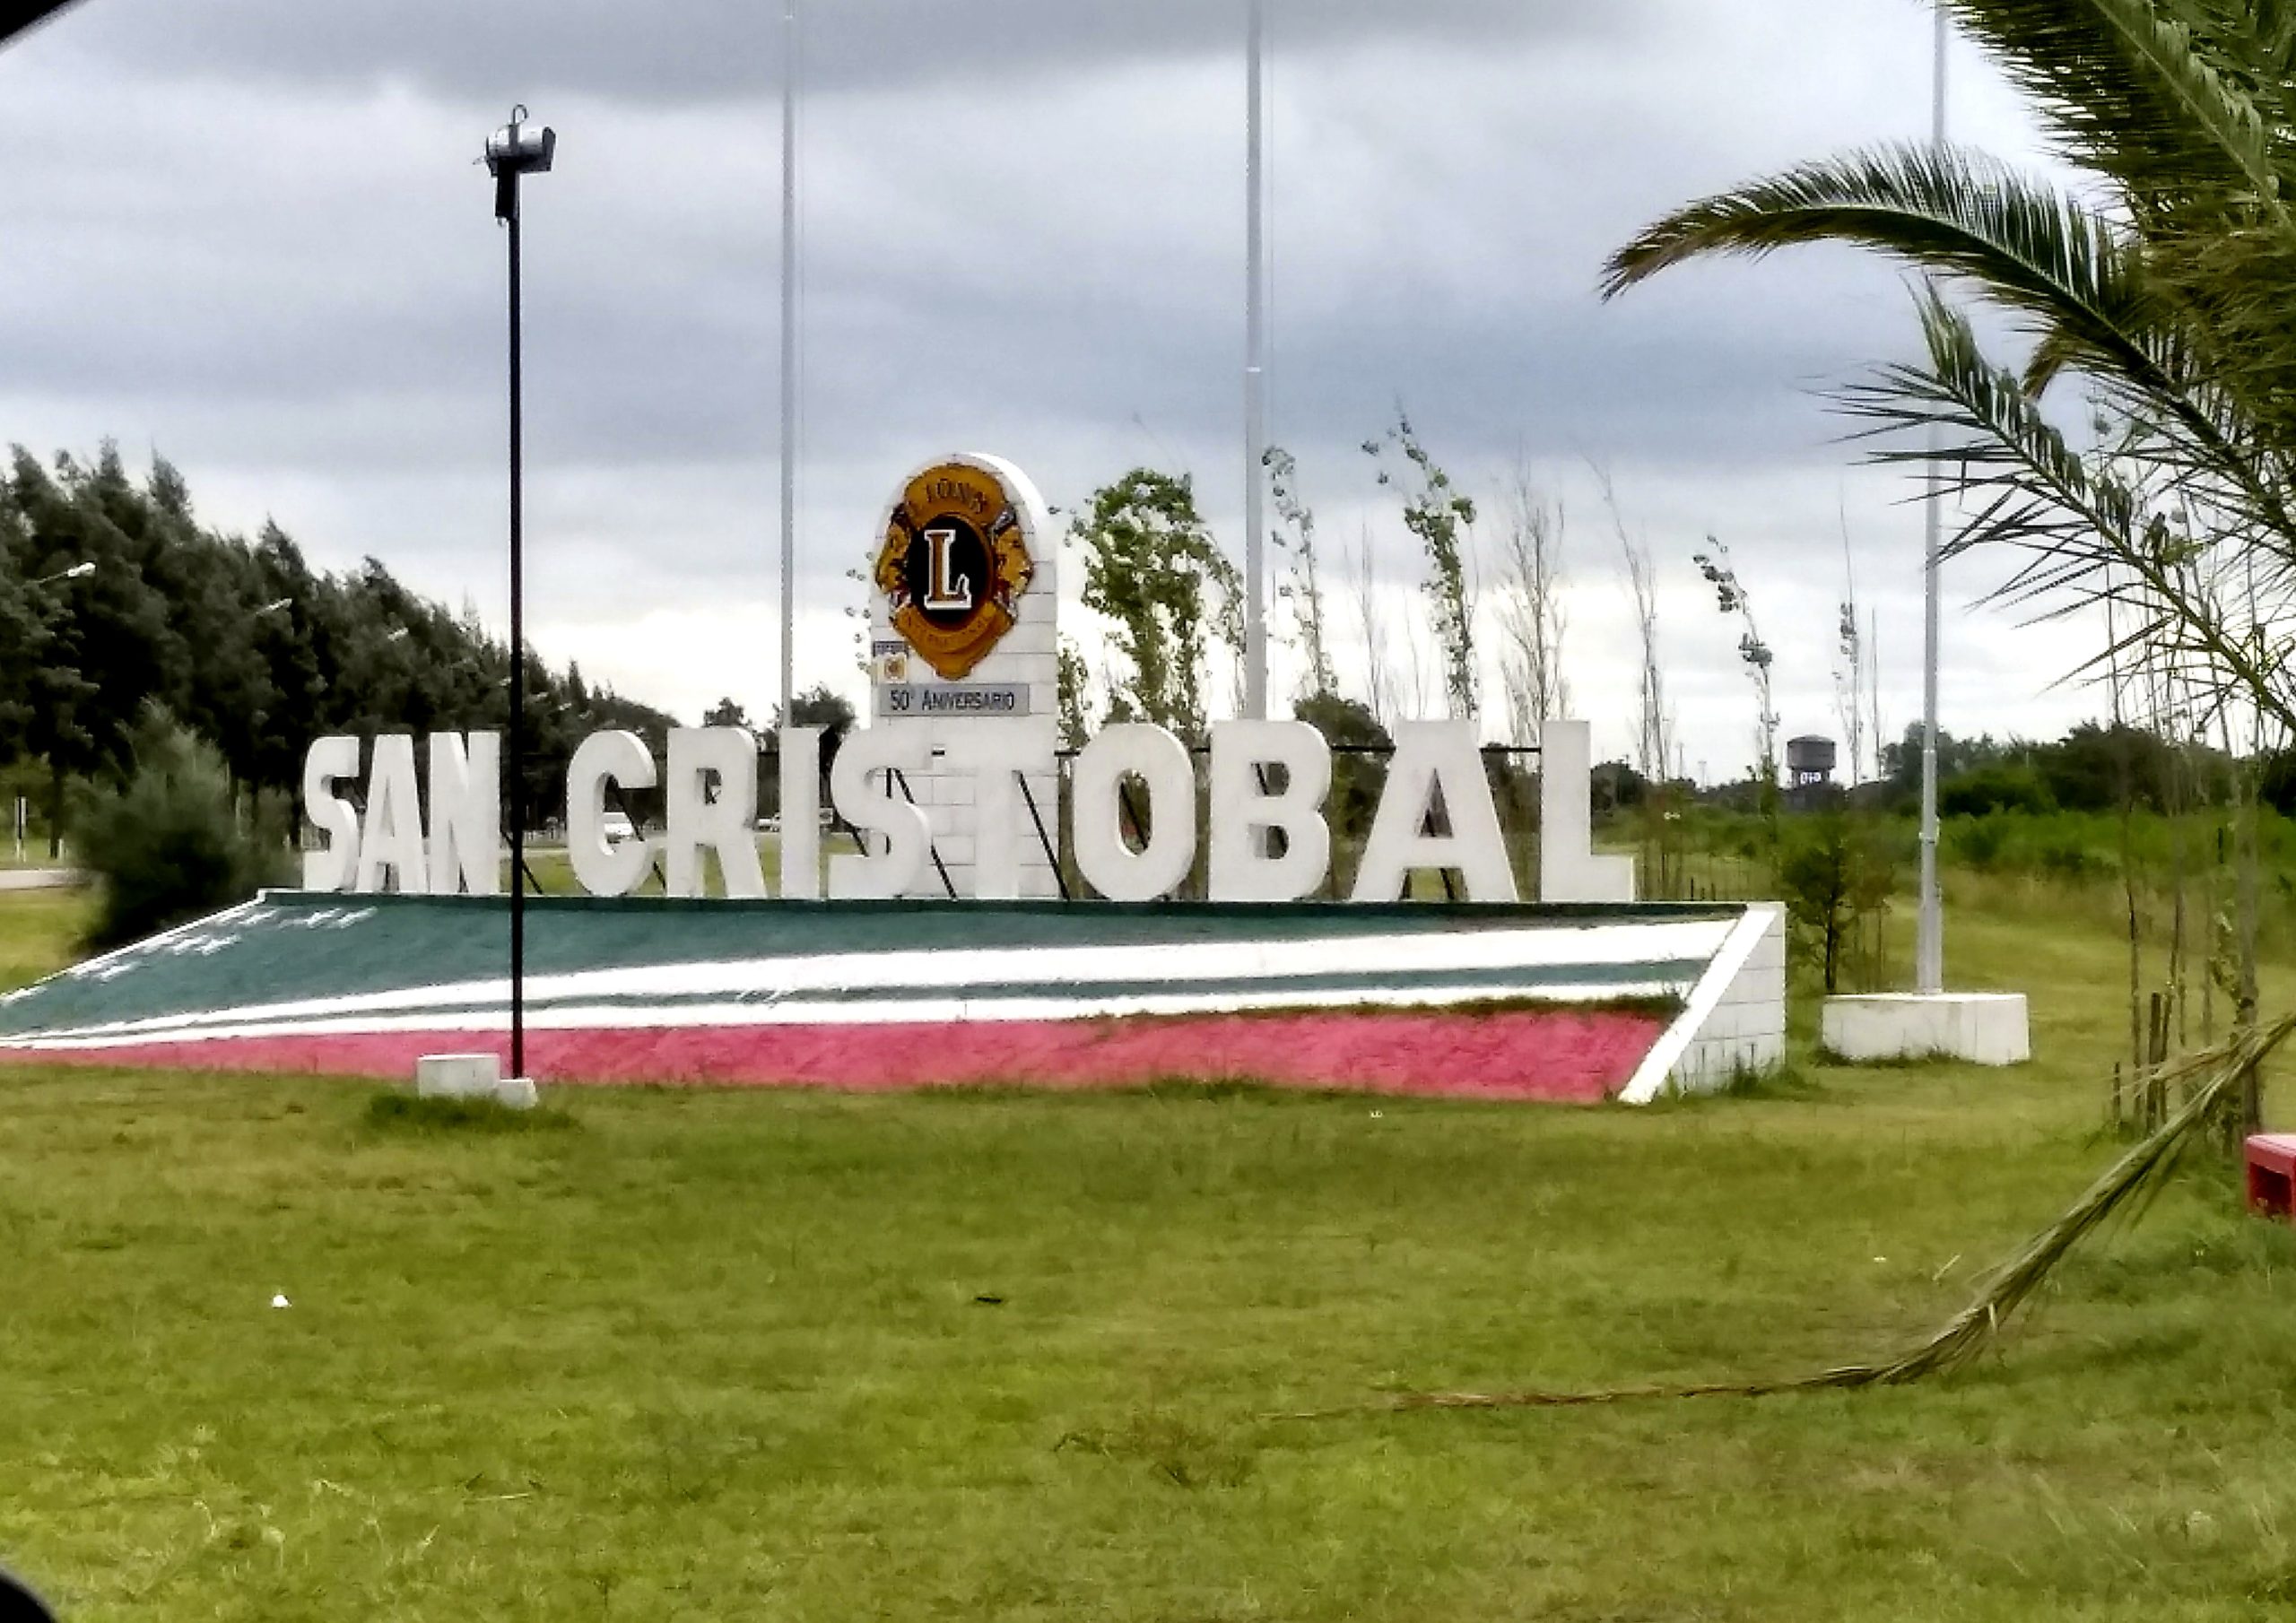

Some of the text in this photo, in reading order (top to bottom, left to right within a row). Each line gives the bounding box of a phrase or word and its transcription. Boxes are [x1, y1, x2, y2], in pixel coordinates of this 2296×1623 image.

[924, 529, 971, 610] L
[921, 689, 1015, 710] ANIVERSARIO
[302, 720, 1636, 902] SAN CRISTOBAL
